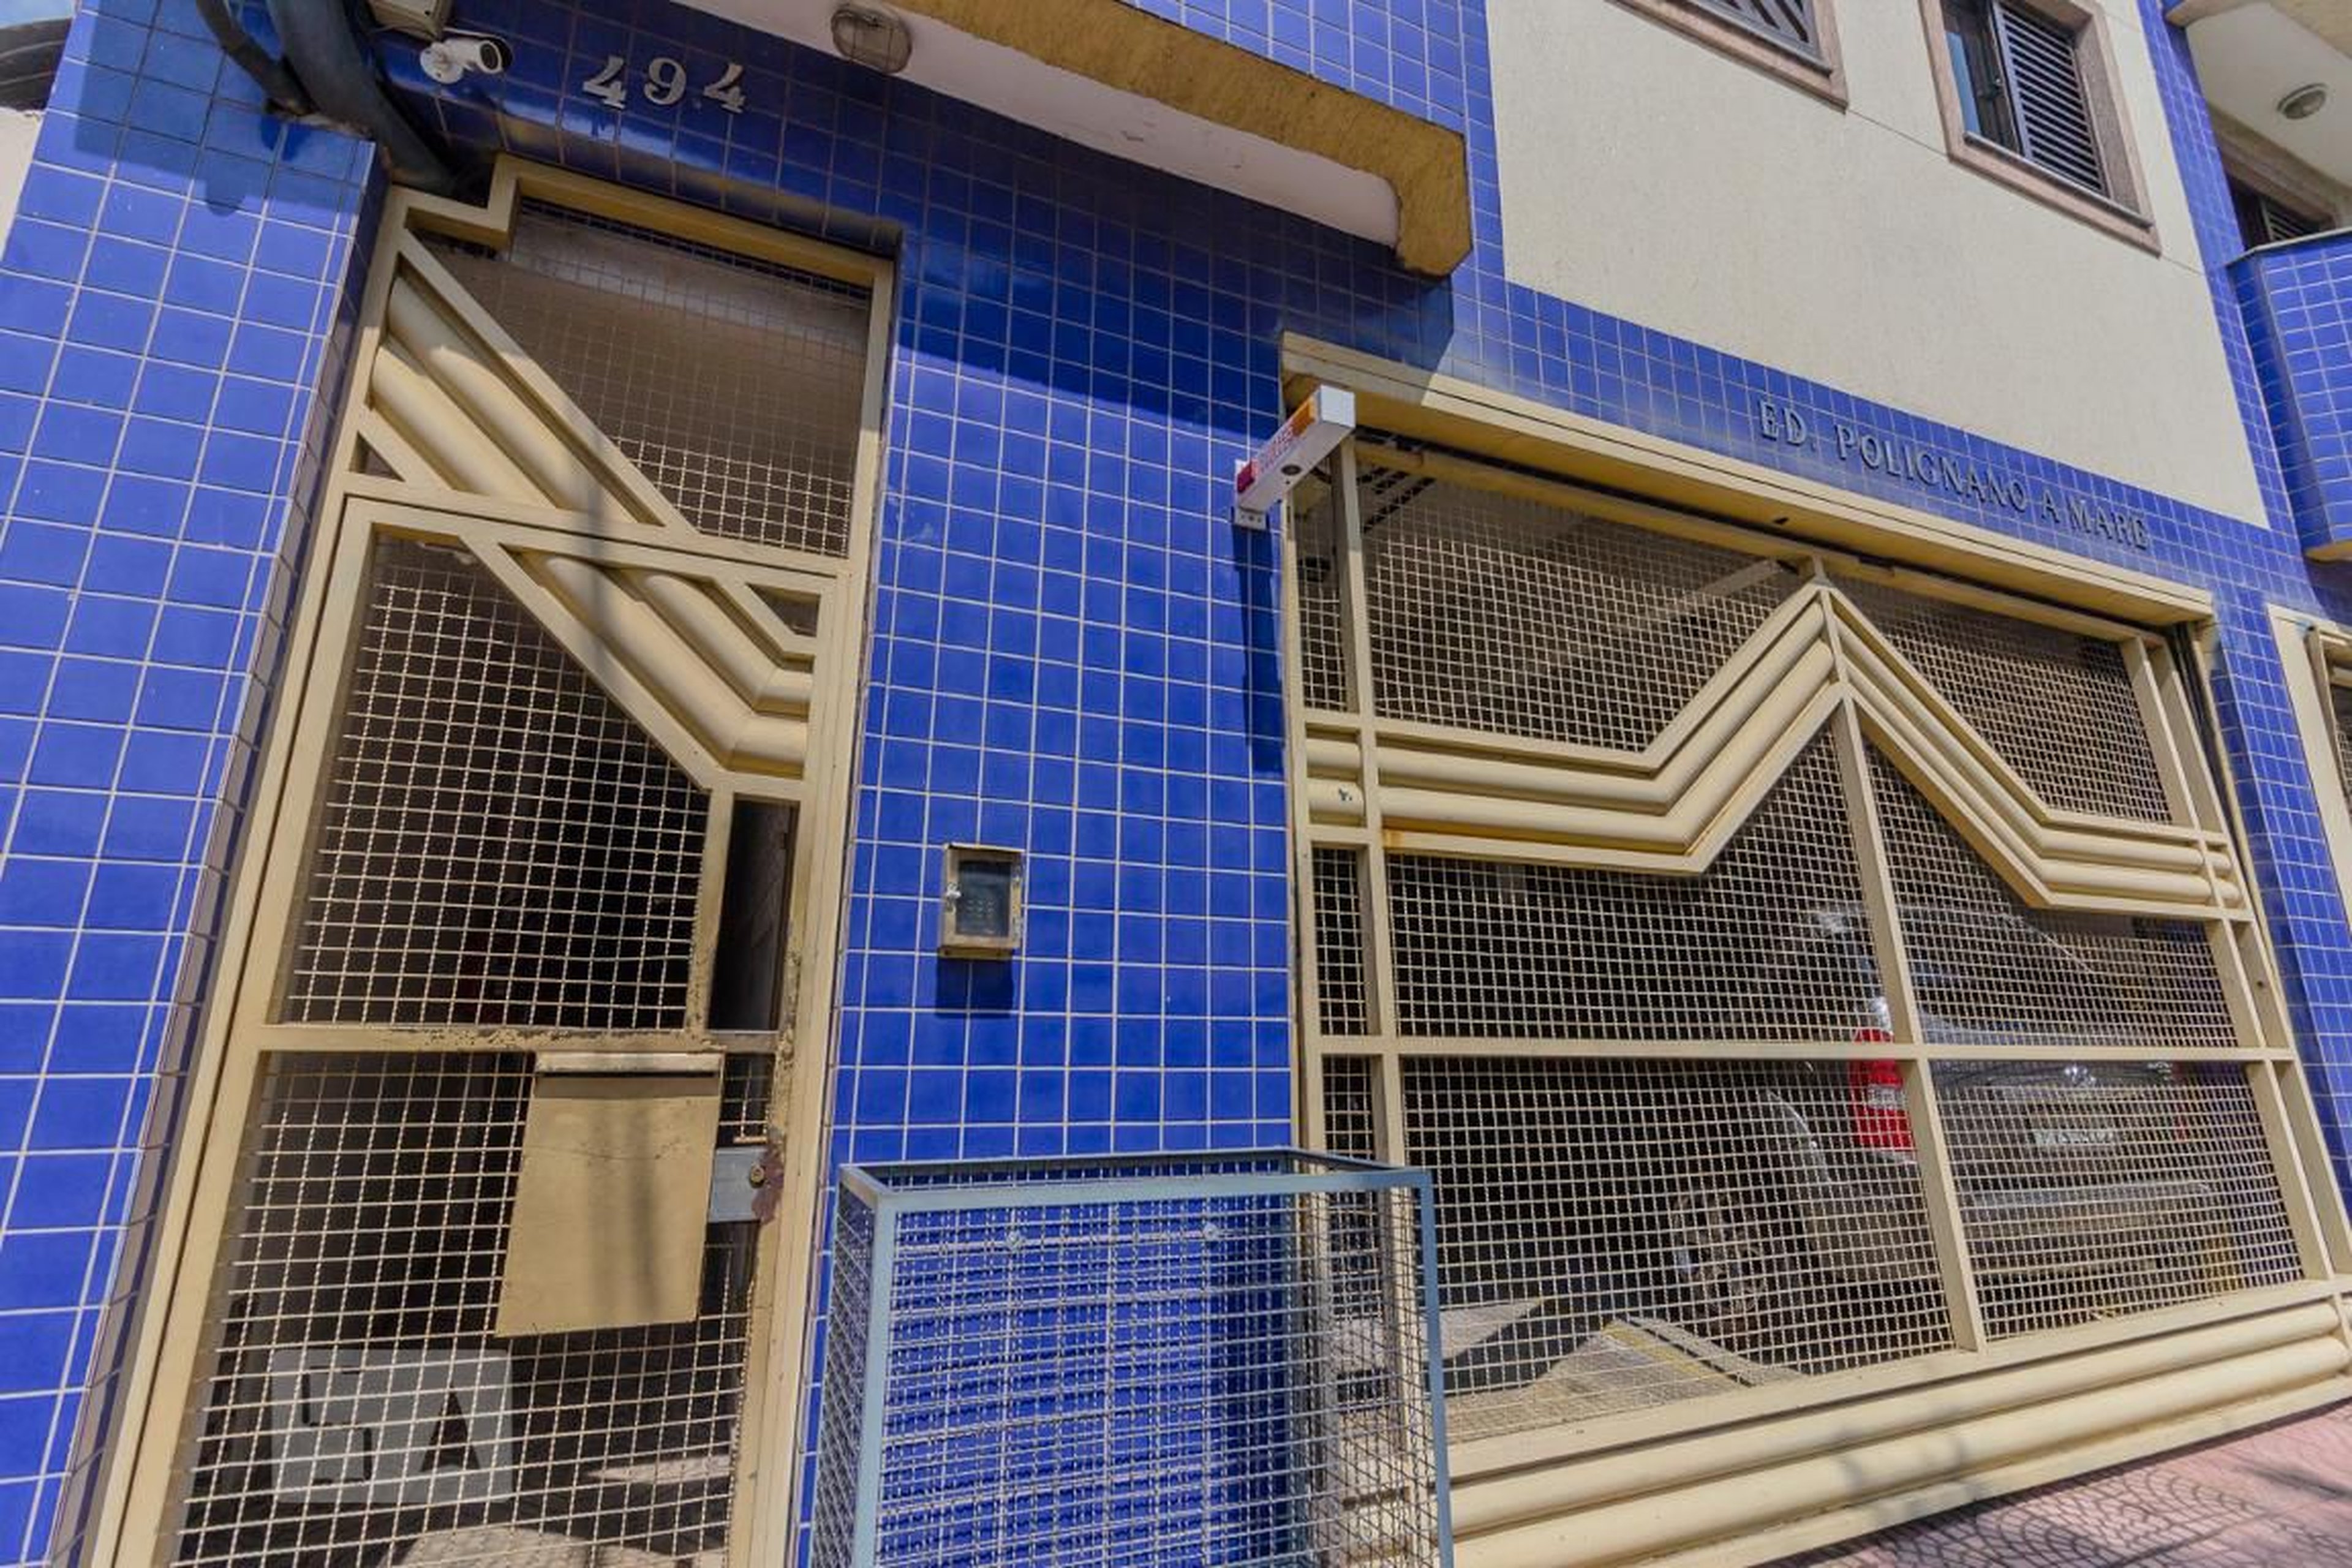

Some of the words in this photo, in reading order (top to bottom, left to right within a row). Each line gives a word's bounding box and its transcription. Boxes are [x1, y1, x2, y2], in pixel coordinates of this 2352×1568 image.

[583, 56, 745, 113] 494
[1759, 400, 1817, 452] ED.
[1834, 424, 2029, 513] POLIGNANO
[2041, 489, 2060, 524] A
[2066, 495, 2149, 550] MARE
